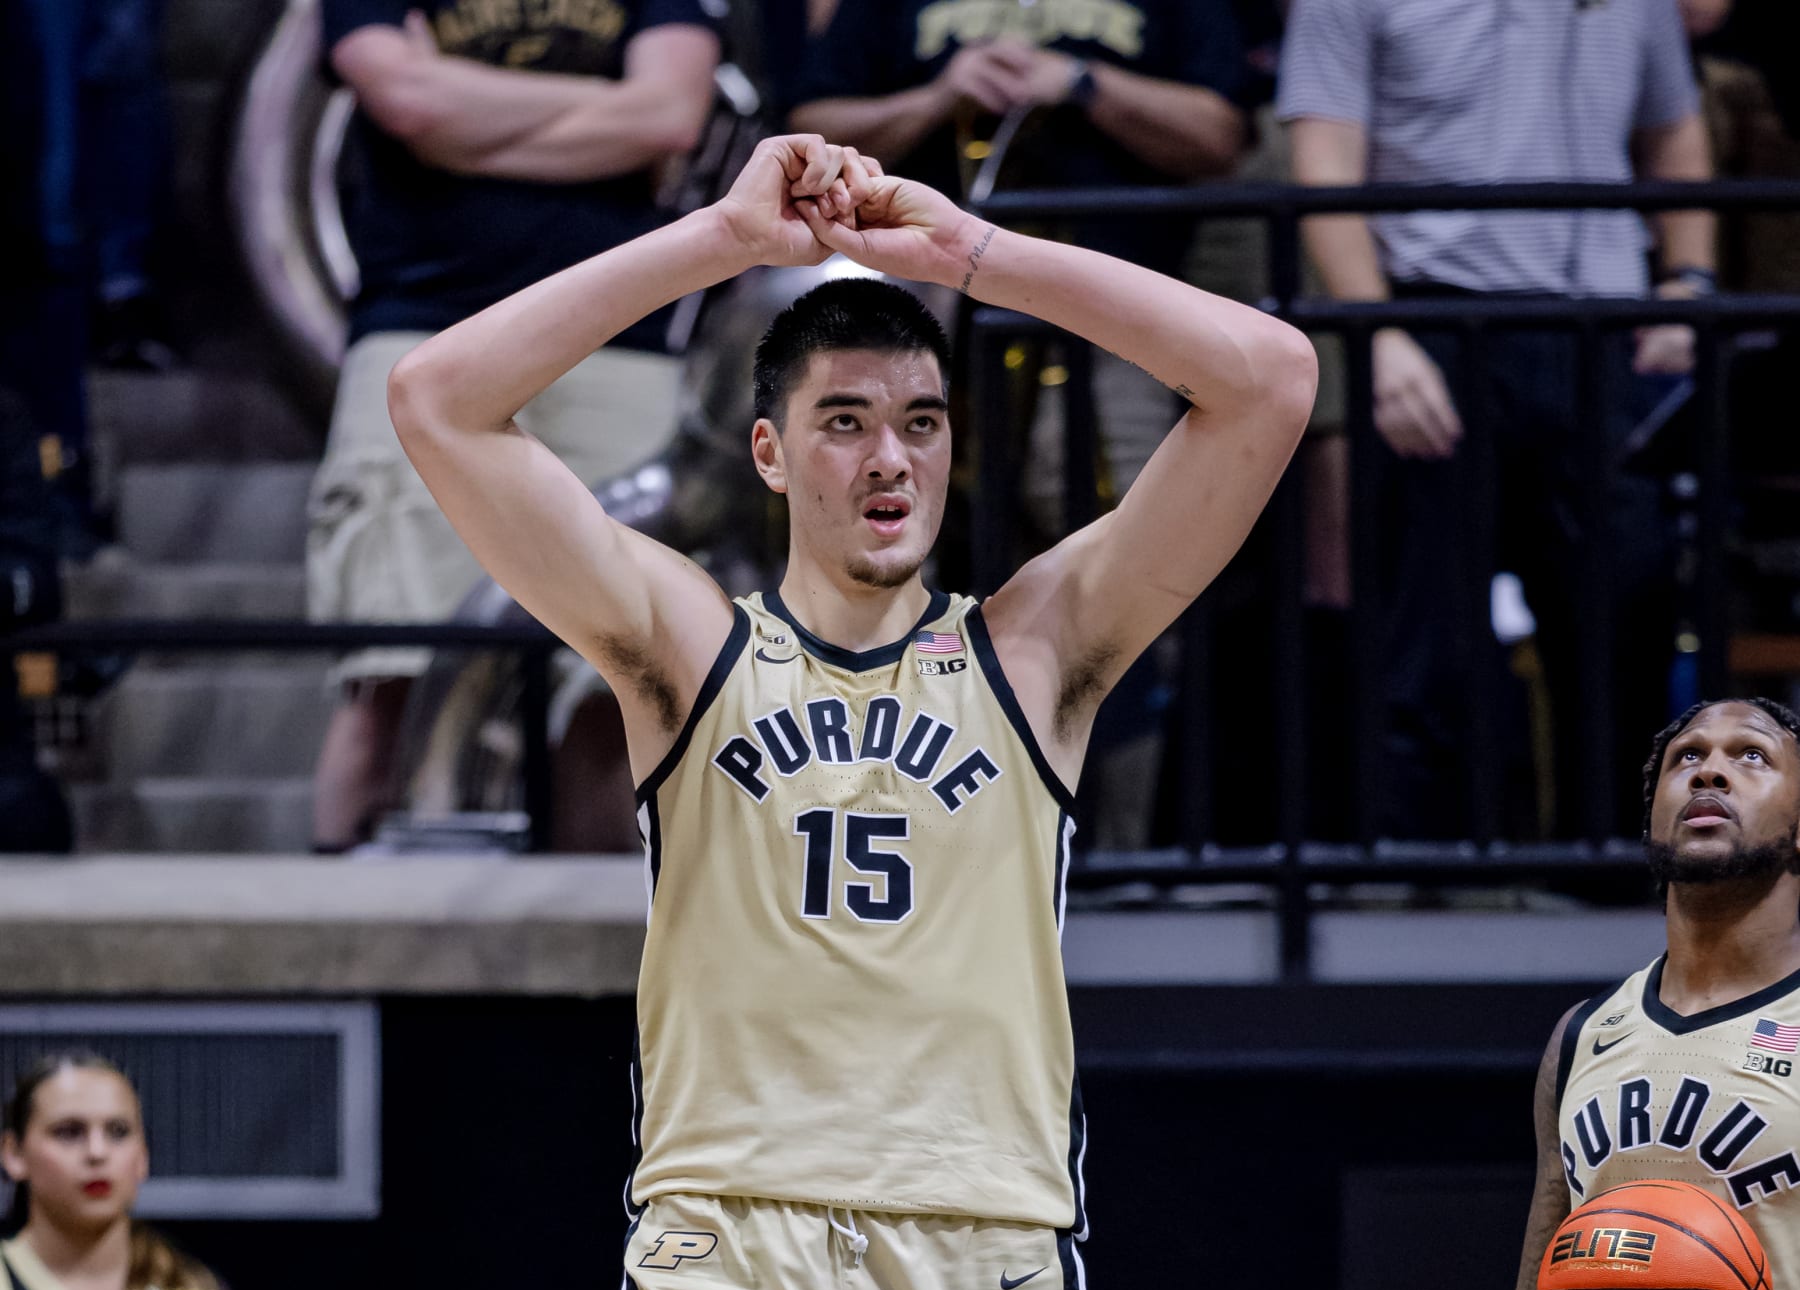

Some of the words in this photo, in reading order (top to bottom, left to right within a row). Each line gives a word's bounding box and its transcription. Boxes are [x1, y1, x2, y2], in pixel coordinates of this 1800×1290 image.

[710, 694, 1004, 816] PURDUE
[792, 806, 915, 925] 15
[1561, 1073, 1800, 1210] PURDUE
[1550, 1227, 1657, 1265] ELITE
